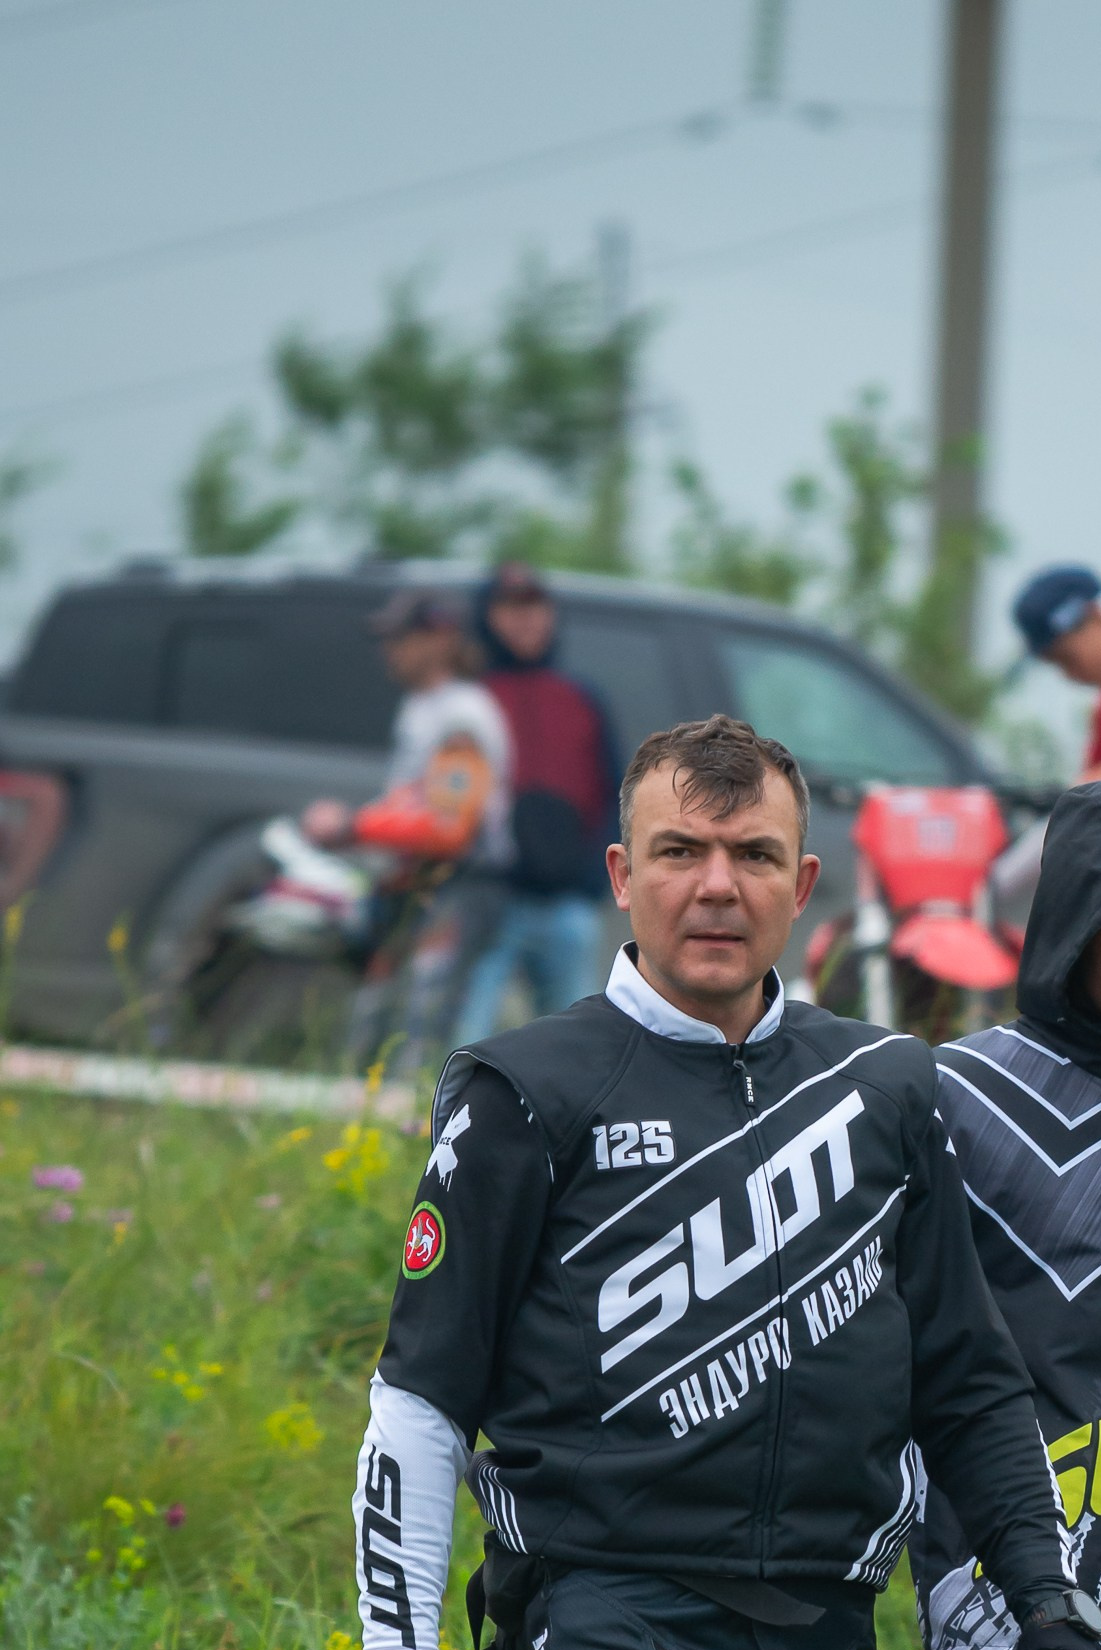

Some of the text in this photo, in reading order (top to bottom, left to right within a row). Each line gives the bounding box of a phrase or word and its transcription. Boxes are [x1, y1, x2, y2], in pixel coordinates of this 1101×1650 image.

[592, 1120, 676, 1170] 125
[659, 1235, 884, 1440] ЭНДУРО КАЗАНЬ
[362, 1443, 417, 1650] SLOT
